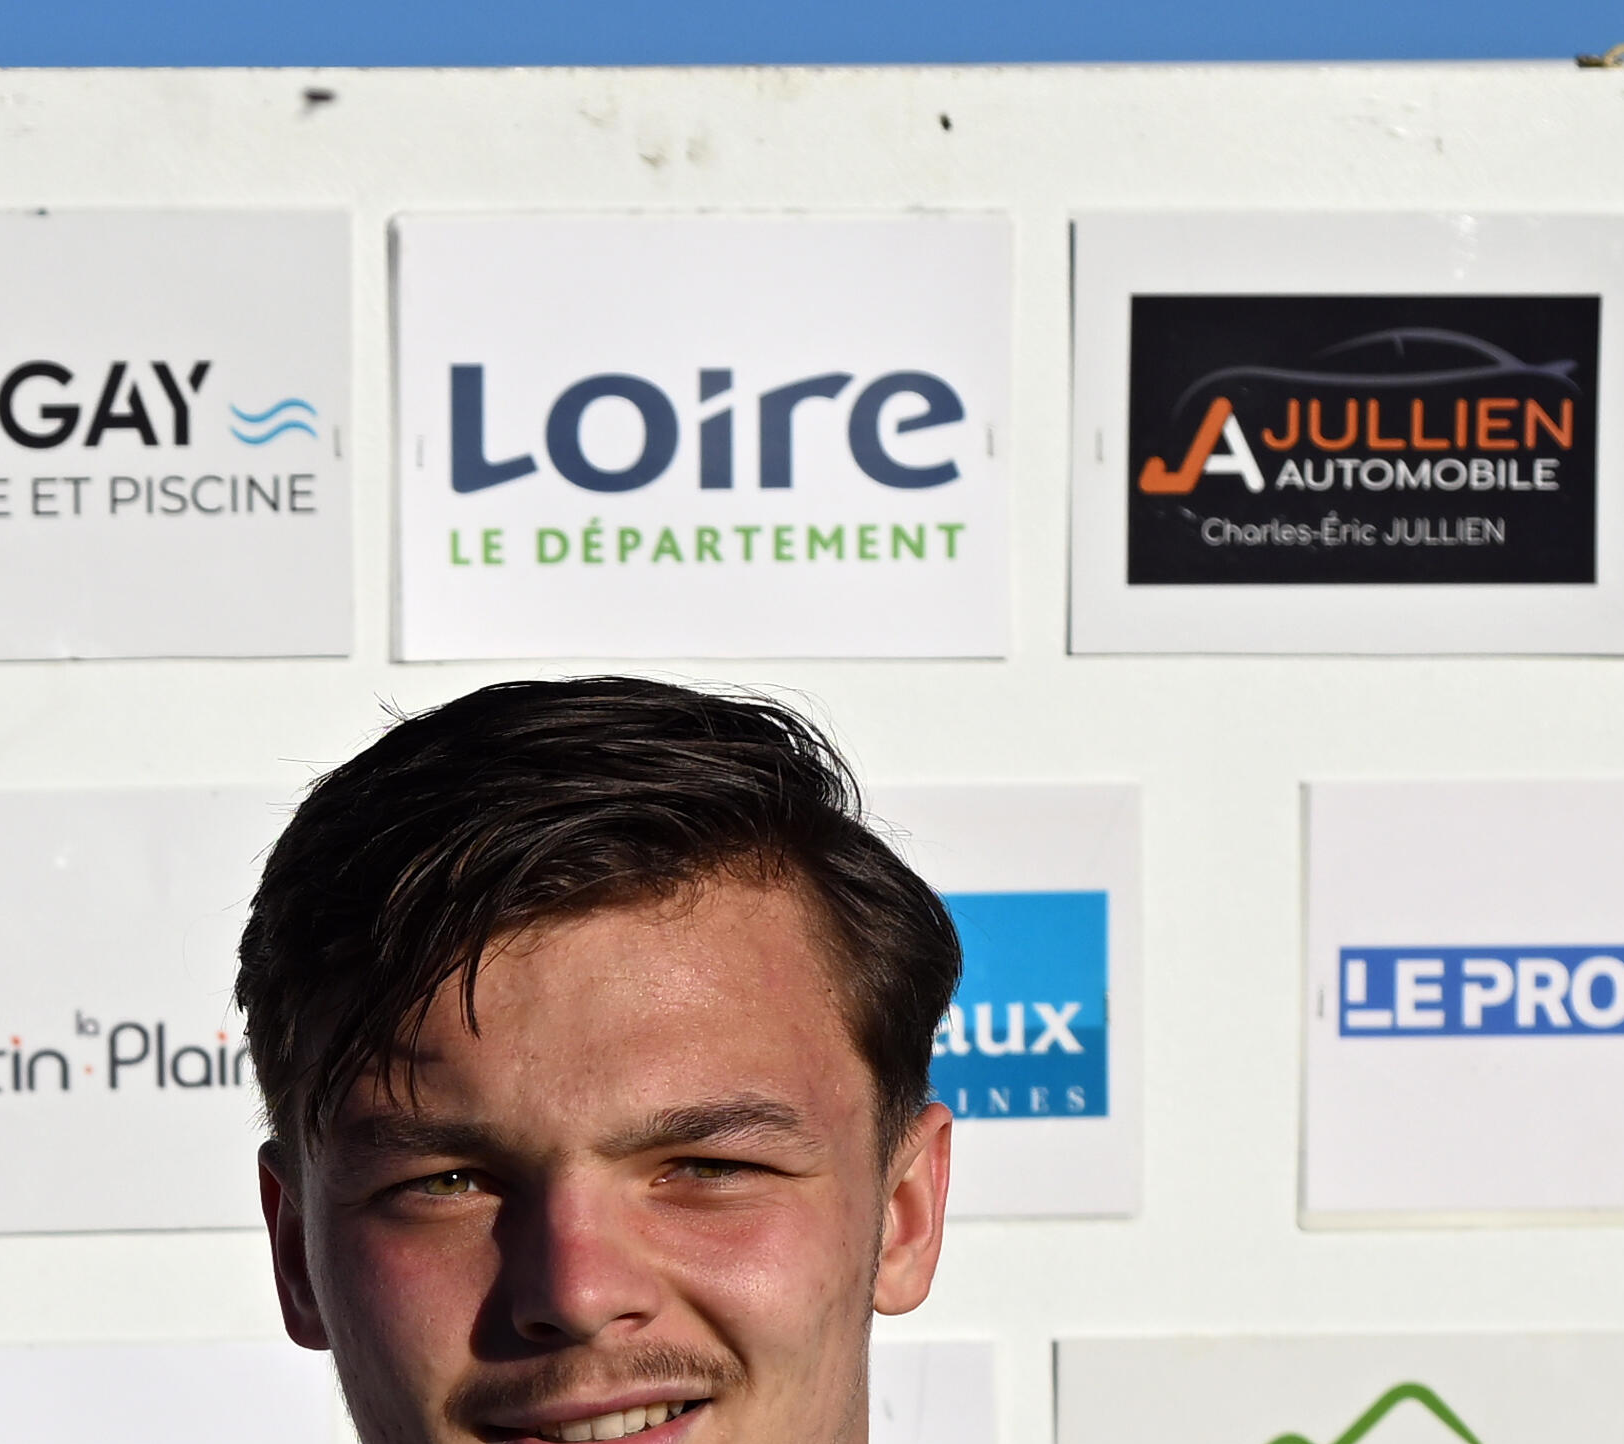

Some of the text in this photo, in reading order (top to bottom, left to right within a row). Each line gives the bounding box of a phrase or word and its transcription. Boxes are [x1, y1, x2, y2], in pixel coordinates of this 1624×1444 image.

[1261, 397, 1575, 451] JULLIEN
[32, 477, 90, 517] ET
[109, 473, 317, 516] PISCINE
[1275, 457, 1561, 492] AUTOMOBILE
[450, 512, 967, 567] LE DÉPARTEMENT
[1201, 509, 1506, 547] Charles-Éric JULLIEN
[1345, 957, 1445, 1030] LE
[75, 1009, 101, 1037] la
[107, 1021, 250, 1090] Plai
